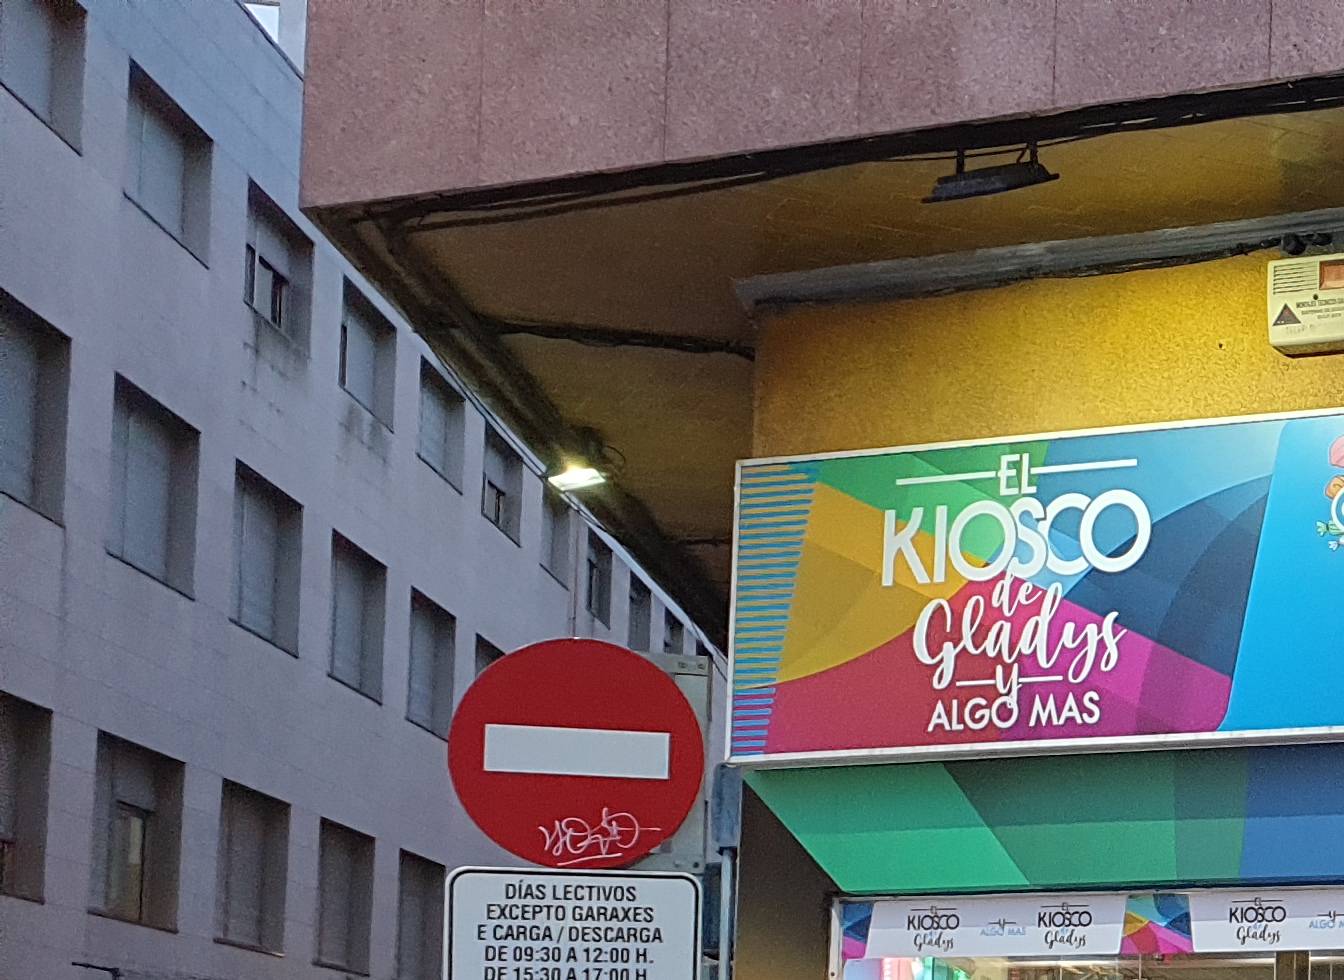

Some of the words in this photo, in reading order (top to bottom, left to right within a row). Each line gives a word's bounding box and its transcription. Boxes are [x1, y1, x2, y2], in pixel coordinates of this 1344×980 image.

[999, 453, 1037, 495] EL
[881, 489, 1152, 586] KIOSCO
[991, 572, 1064, 616] de
[912, 598, 1128, 691] Gladys
[995, 661, 1021, 709] y
[928, 695, 1020, 732] ALGO
[1029, 690, 1101, 727] MAS
[505, 879, 546, 901] DÍAS
[552, 885, 637, 902] LECTIVOS
[486, 904, 566, 922] EXCEPTO
[572, 906, 654, 923] GARAXES
[907, 914, 960, 931] KIOSCO
[1038, 910, 1092, 928] KIOSCO
[1229, 905, 1287, 924] KIOSCO
[477, 924, 487, 941] E
[493, 925, 553, 942] CARGA
[556, 926, 564, 942] /
[568, 926, 663, 944] DESCARGA
[1309, 919, 1335, 929] ALGO
[914, 931, 954, 953] Gladys
[1044, 929, 1086, 948] Gladys
[1236, 925, 1281, 945] Gladys
[485, 947, 508, 962] DE
[513, 947, 560, 963] 09:30
[566, 948, 578, 963] A
[583, 947, 630, 964] 12:00
[635, 949, 654, 965] H.
